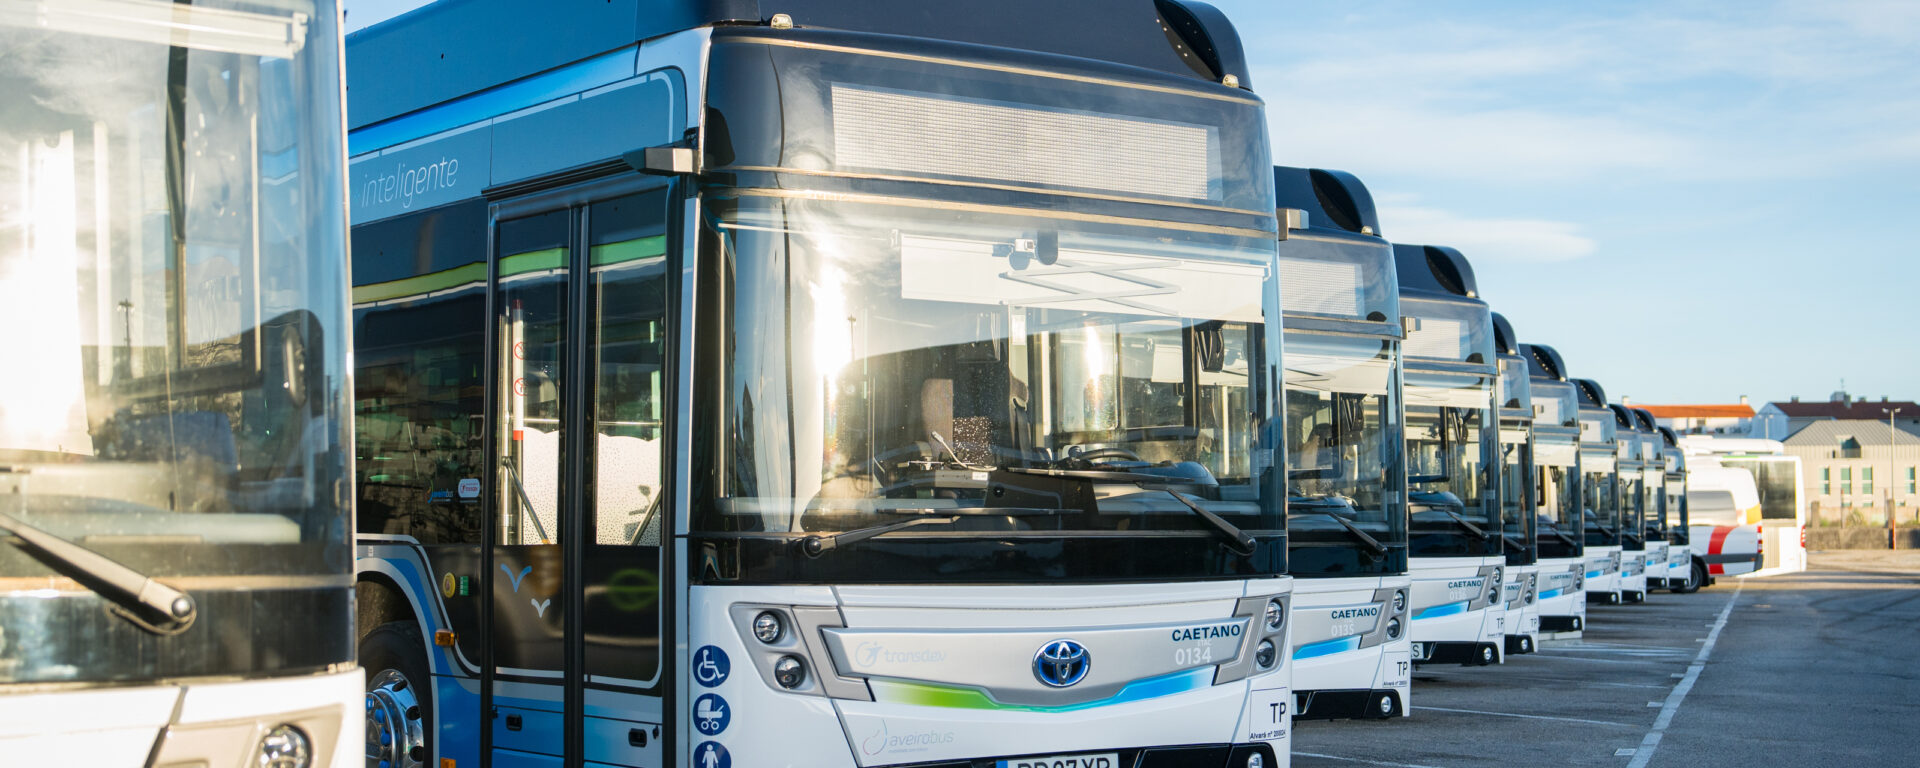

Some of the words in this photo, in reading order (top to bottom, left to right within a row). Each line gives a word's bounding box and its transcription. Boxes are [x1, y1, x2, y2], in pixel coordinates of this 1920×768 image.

[361, 156, 459, 208] inteligente
[1448, 580, 1482, 588] CAETANO
[1331, 607, 1378, 619] CAETANO
[1331, 623, 1354, 636] 0135
[1496, 617, 1504, 629] TP
[1172, 624, 1241, 641] CAETANO
[885, 648, 947, 663] transdev
[1175, 646, 1212, 665] 0134
[1397, 661, 1408, 676] TP
[1270, 701, 1286, 723] TP
[889, 730, 955, 746] aveirobus
